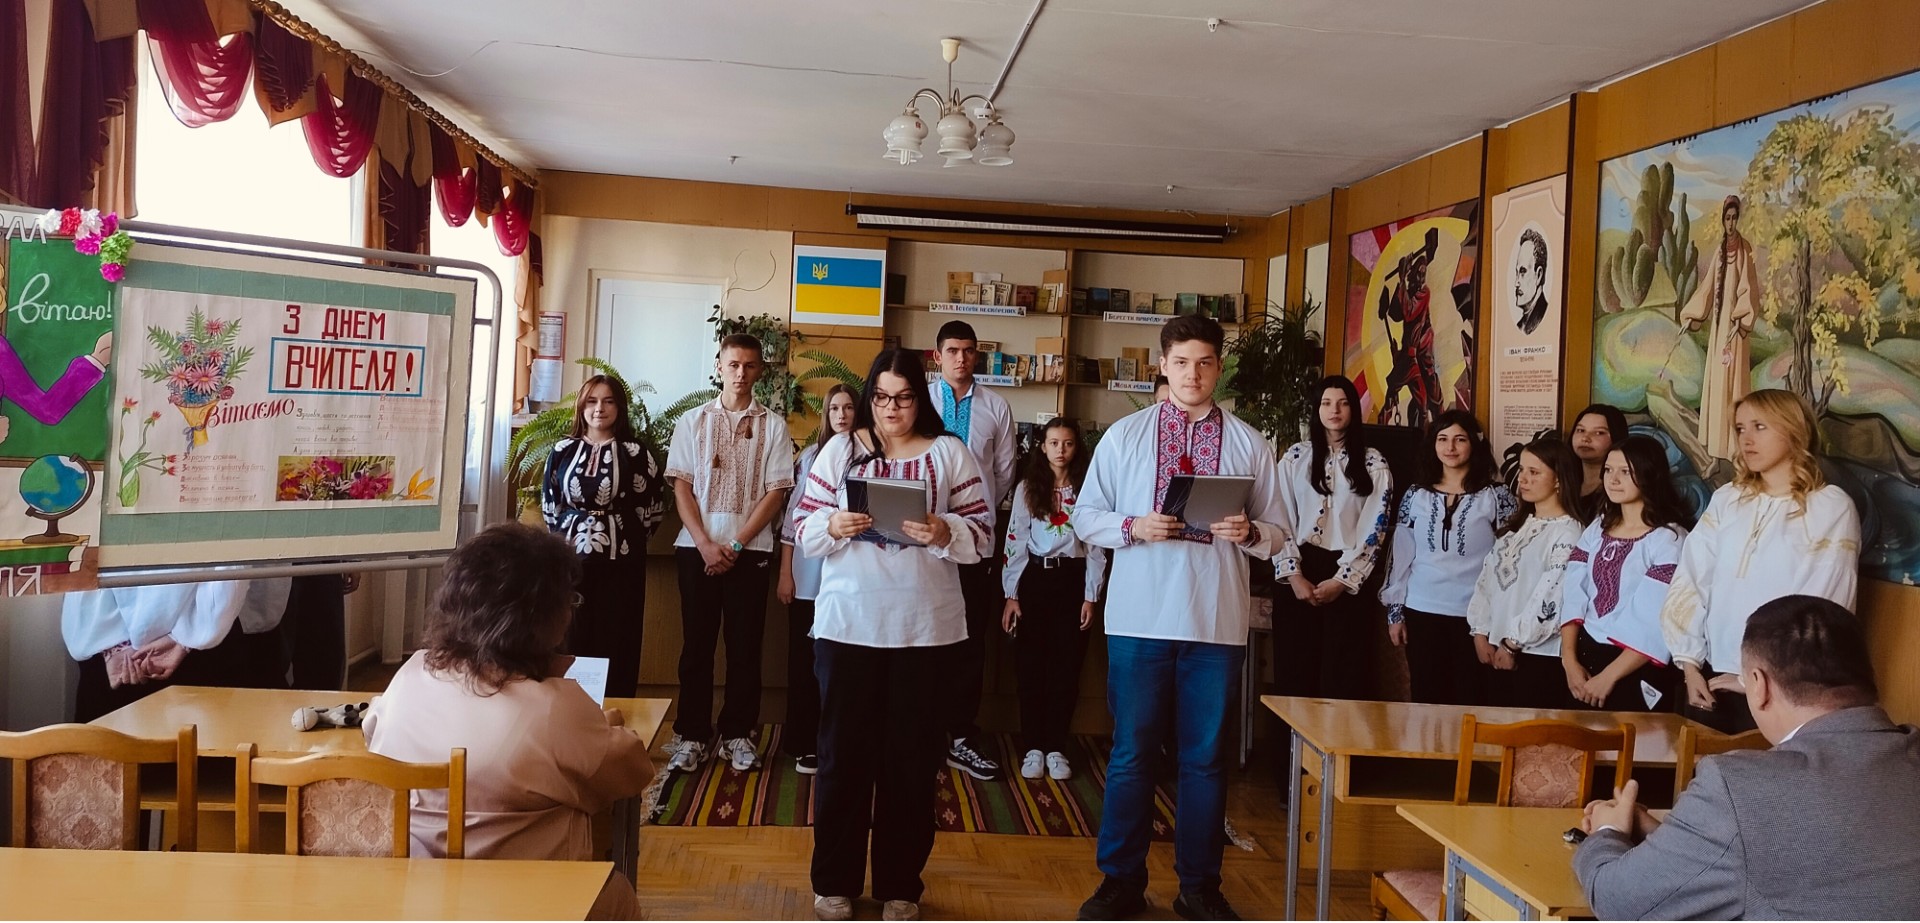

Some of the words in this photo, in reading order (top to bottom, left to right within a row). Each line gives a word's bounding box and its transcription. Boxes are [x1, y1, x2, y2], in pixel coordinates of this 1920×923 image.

[8, 273, 112, 324] вітаю!
[283, 304, 301, 335] З
[321, 307, 386, 341] ДНЕМ
[204, 398, 296, 429] Вітаємо
